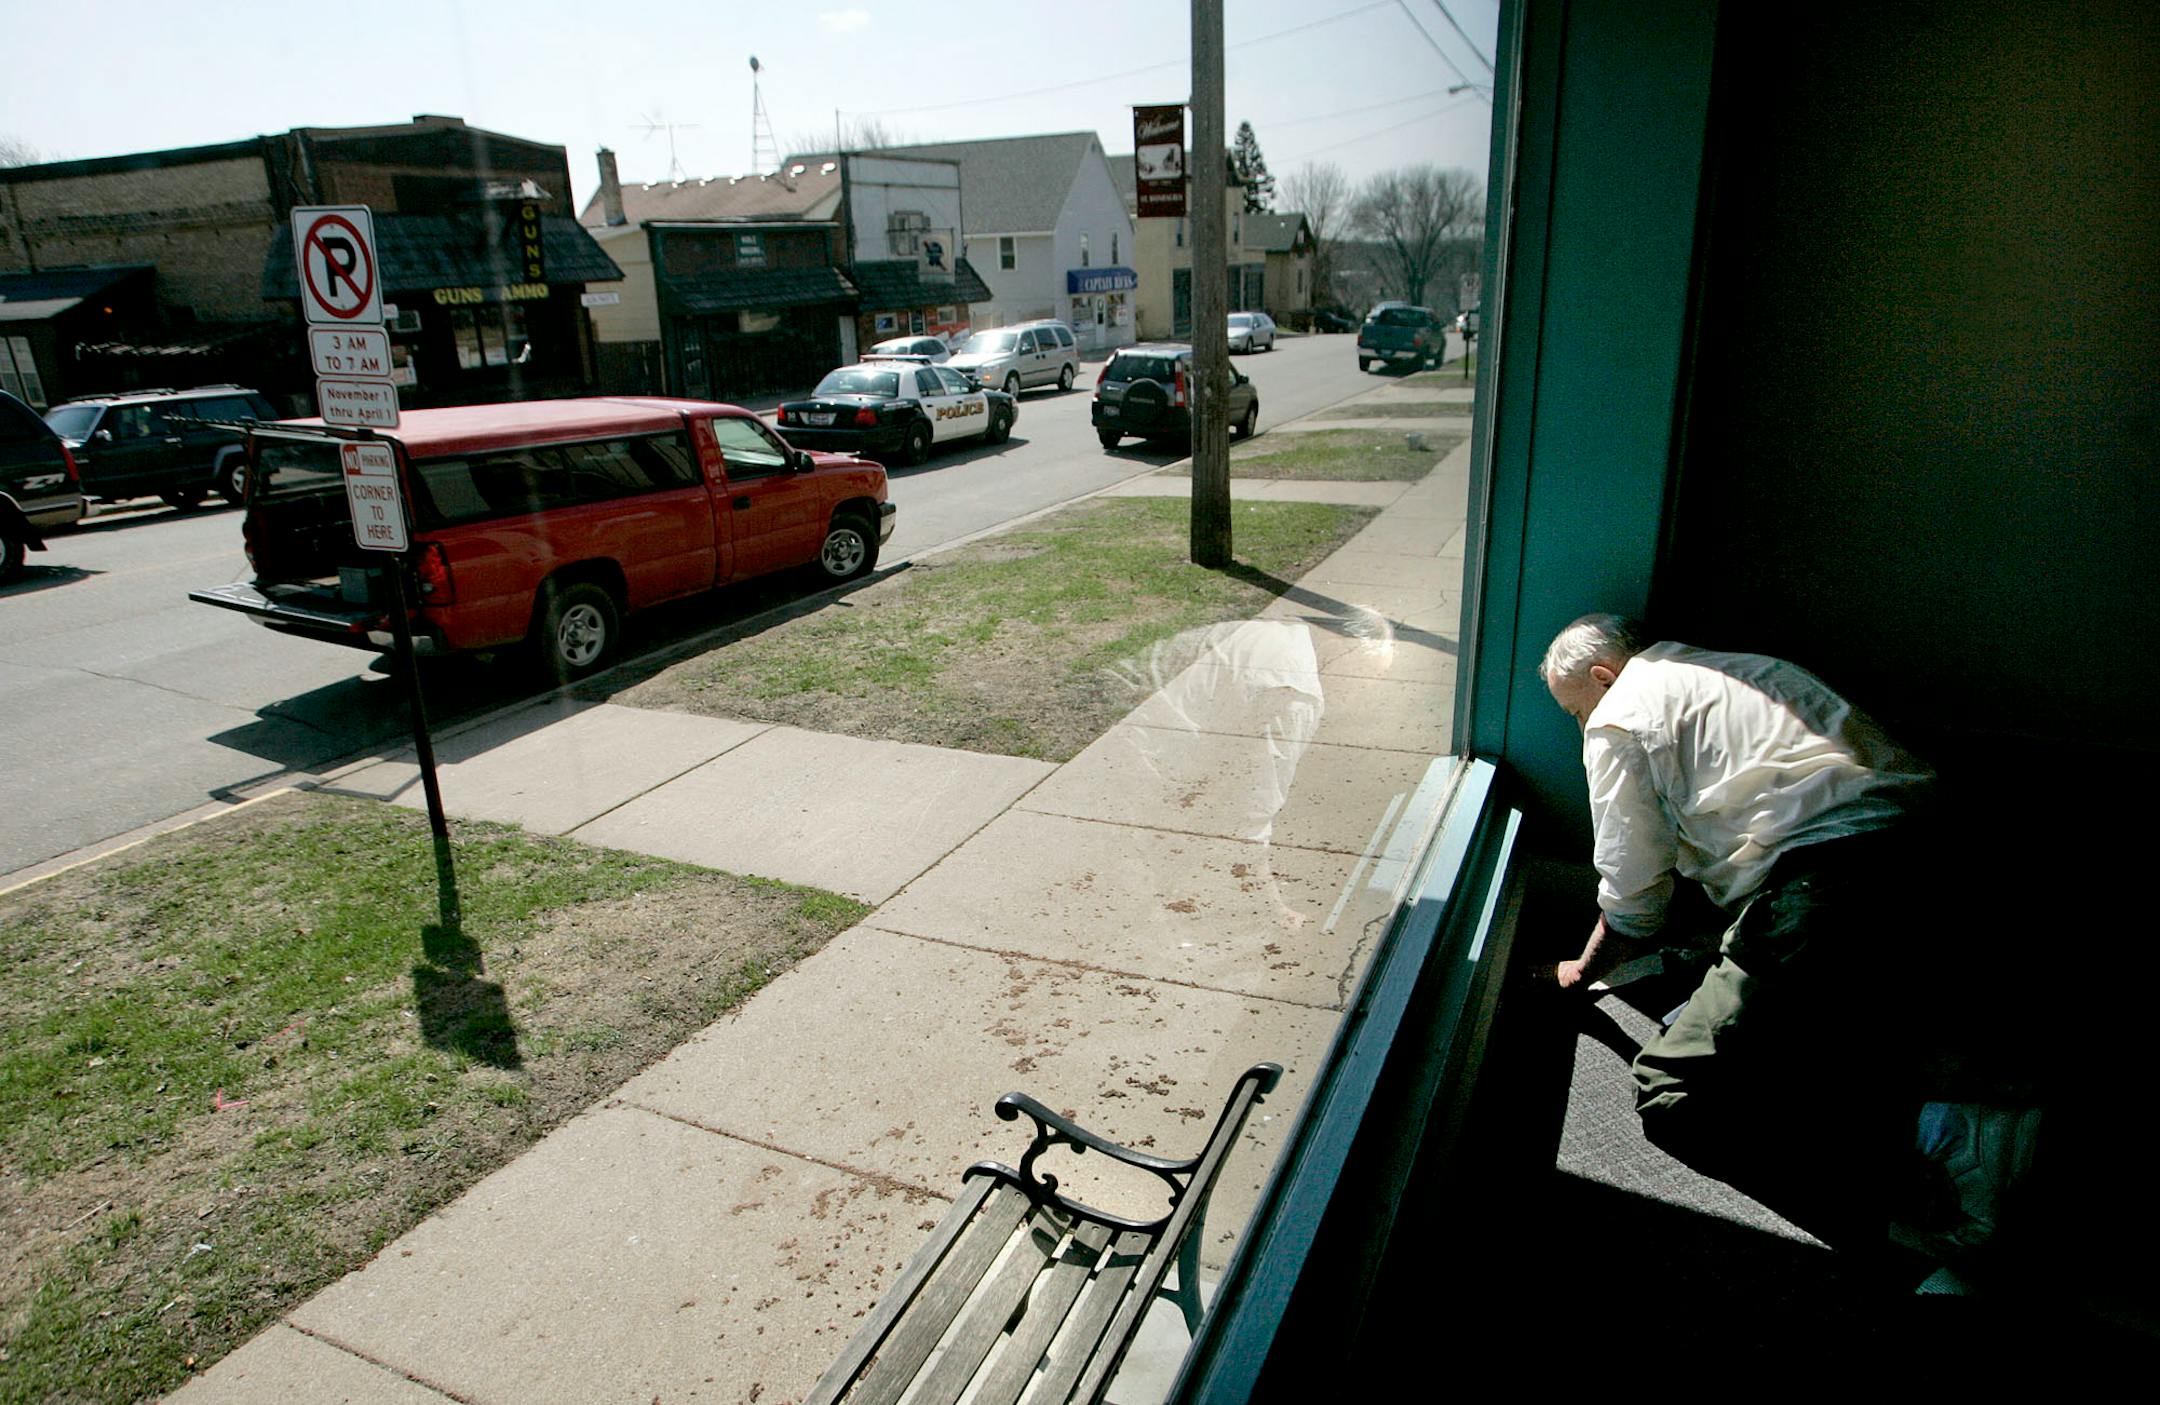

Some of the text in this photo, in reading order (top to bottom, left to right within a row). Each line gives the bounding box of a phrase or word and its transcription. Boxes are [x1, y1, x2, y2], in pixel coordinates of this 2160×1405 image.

[521, 205, 542, 279] GUNS
[433, 283, 549, 305] GUNS AMMO
[333, 335, 367, 350] 3 AM
[324, 355, 380, 371] TO 7 AM
[327, 388, 379, 401] November
[330, 405, 352, 417] thru
[358, 407, 383, 420] April
[936, 402, 984, 421] POLICE
[345, 450, 390, 470] NO PARKING
[353, 484, 394, 502] CORNER
[370, 504, 384, 521] TO
[367, 524, 395, 541] HERE
